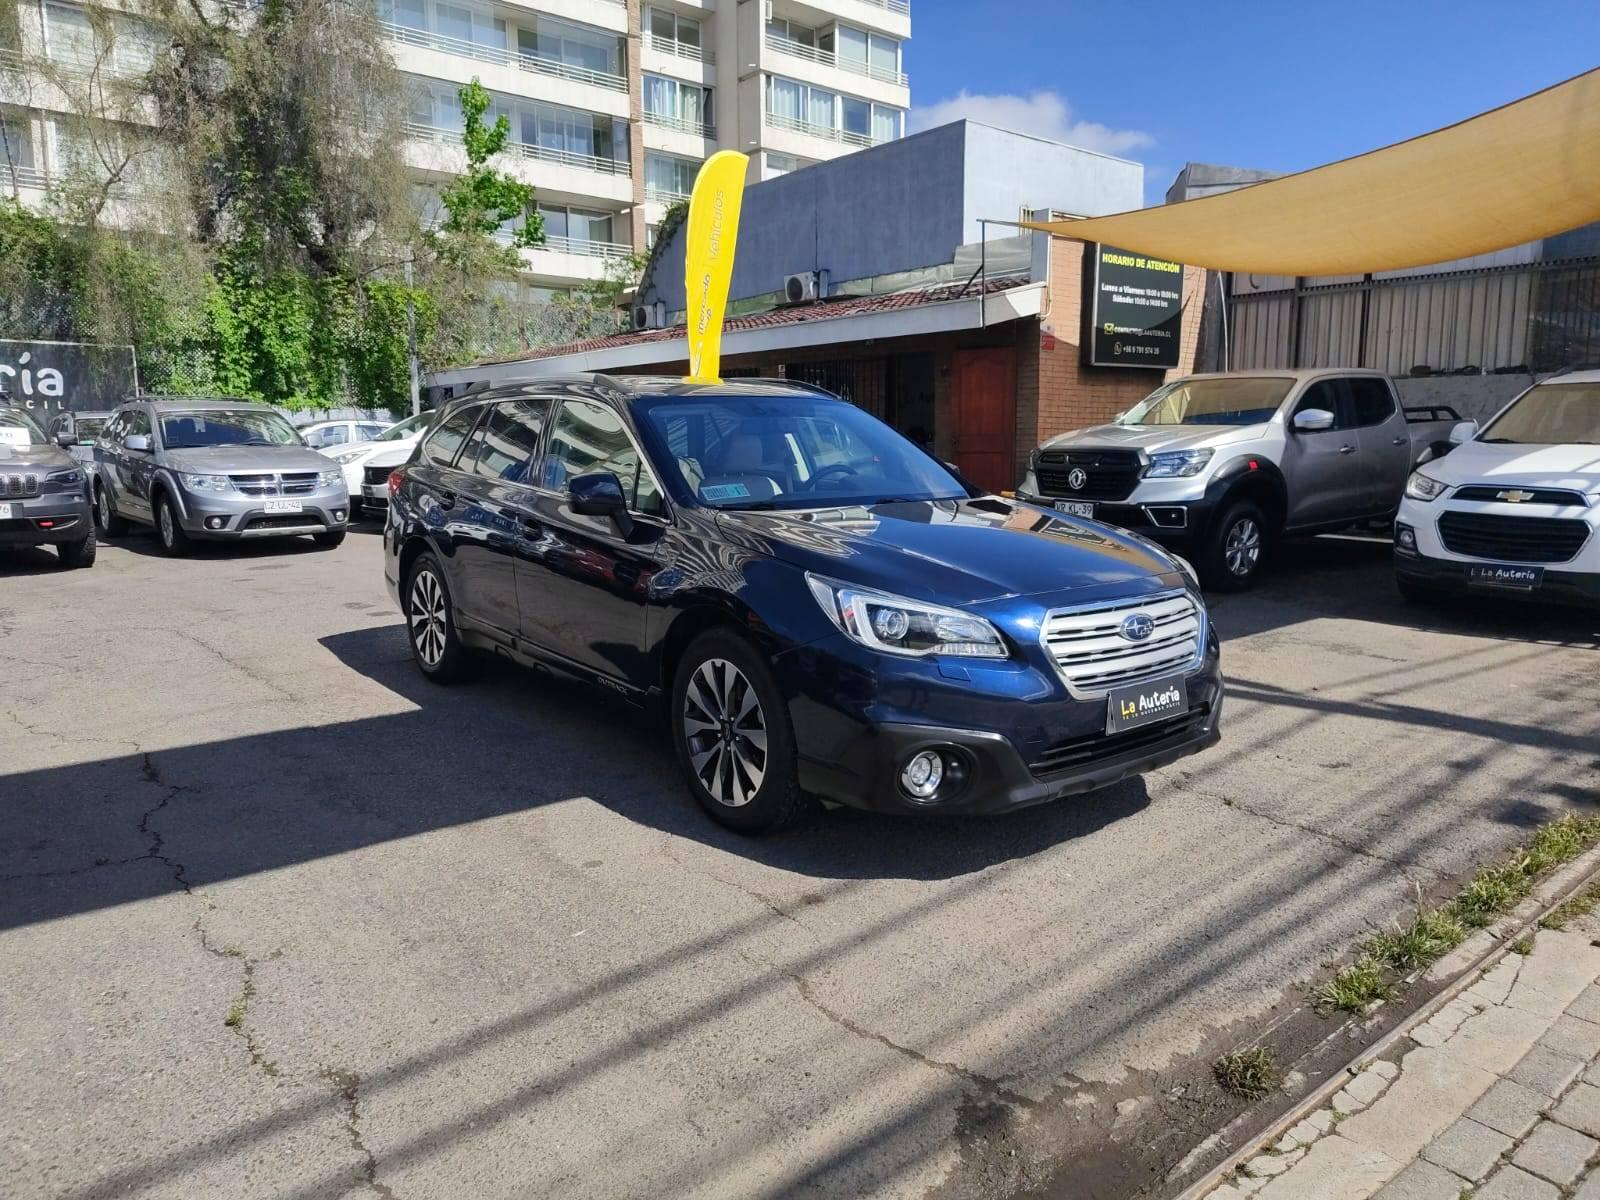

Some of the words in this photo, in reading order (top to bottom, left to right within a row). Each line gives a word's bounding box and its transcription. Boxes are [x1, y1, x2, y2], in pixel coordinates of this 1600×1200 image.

[1102, 252, 1135, 267] HORARIO
[1136, 258, 1145, 268] DE
[1146, 259, 1180, 274] ATENCIÓN
[1121, 699, 1136, 716] La
[1139, 685, 1180, 711] Autería
